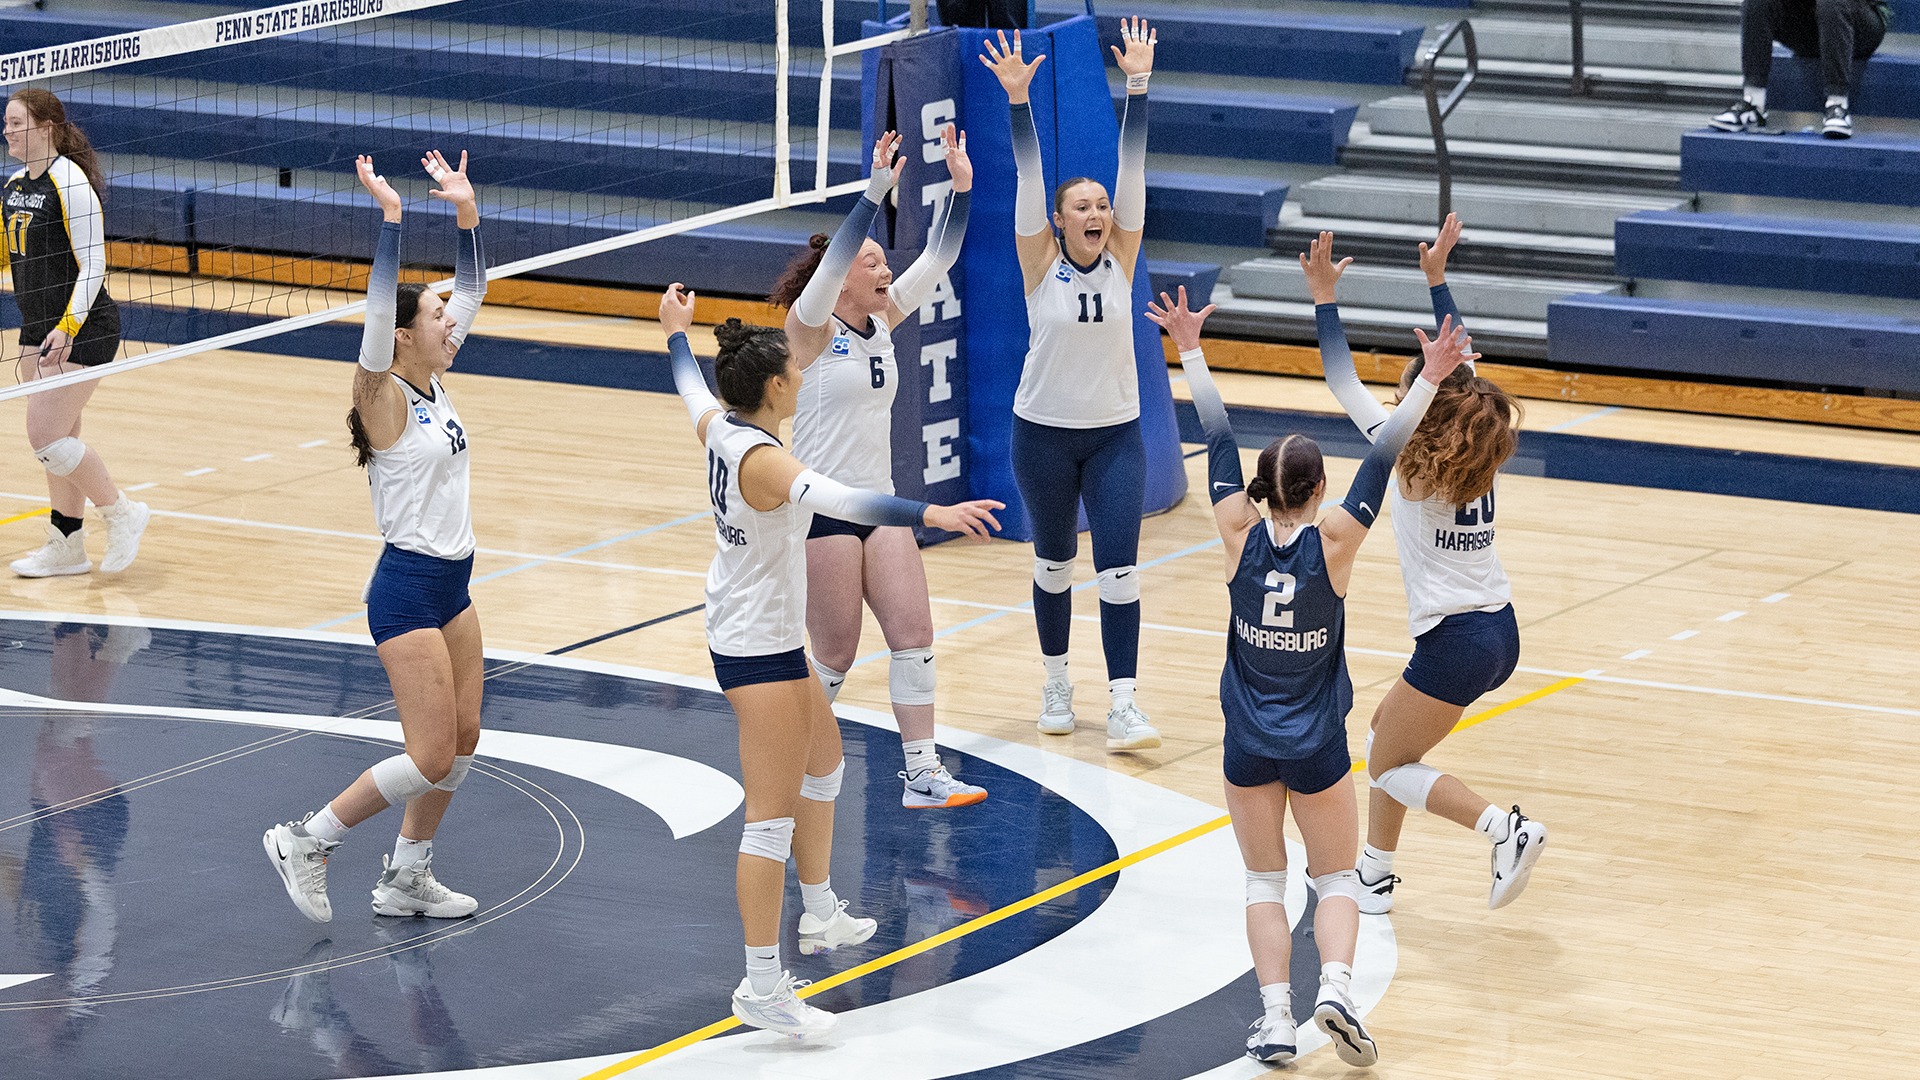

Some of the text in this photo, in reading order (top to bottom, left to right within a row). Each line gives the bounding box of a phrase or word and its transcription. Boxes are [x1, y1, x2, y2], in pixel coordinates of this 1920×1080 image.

[215, 0, 383, 43] PENN STATE HARRISBURG
[0, 35, 141, 81] STATE HARRISBURG
[8, 210, 34, 256] 17
[919, 98, 962, 485] STATE
[1078, 293, 1104, 322] 11
[869, 356, 886, 389] 6
[440, 419, 466, 455] 12
[708, 448, 728, 516] 10
[1262, 569, 1296, 629] 2
[1235, 615, 1328, 653] HARRISBURG
